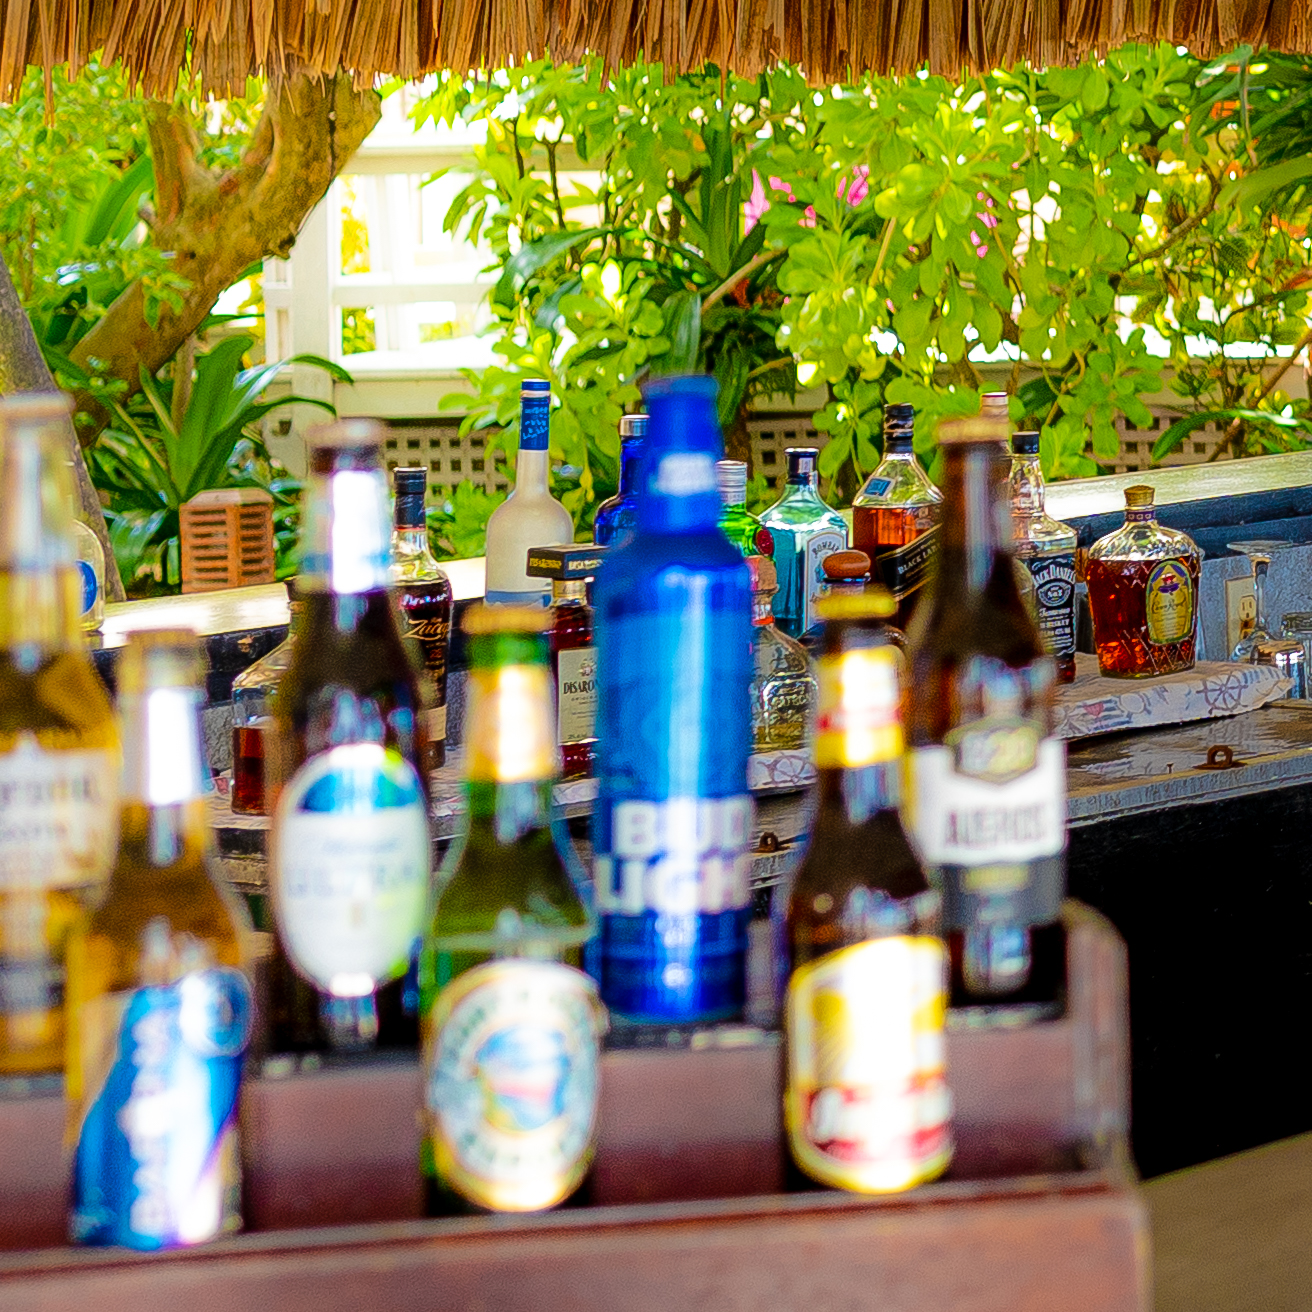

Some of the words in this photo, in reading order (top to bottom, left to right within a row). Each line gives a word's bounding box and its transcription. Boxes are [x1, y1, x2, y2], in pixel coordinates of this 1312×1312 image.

[897, 553, 922, 575] BLACK
[612, 795, 755, 858] BUD
[594, 851, 753, 915] LIGH
